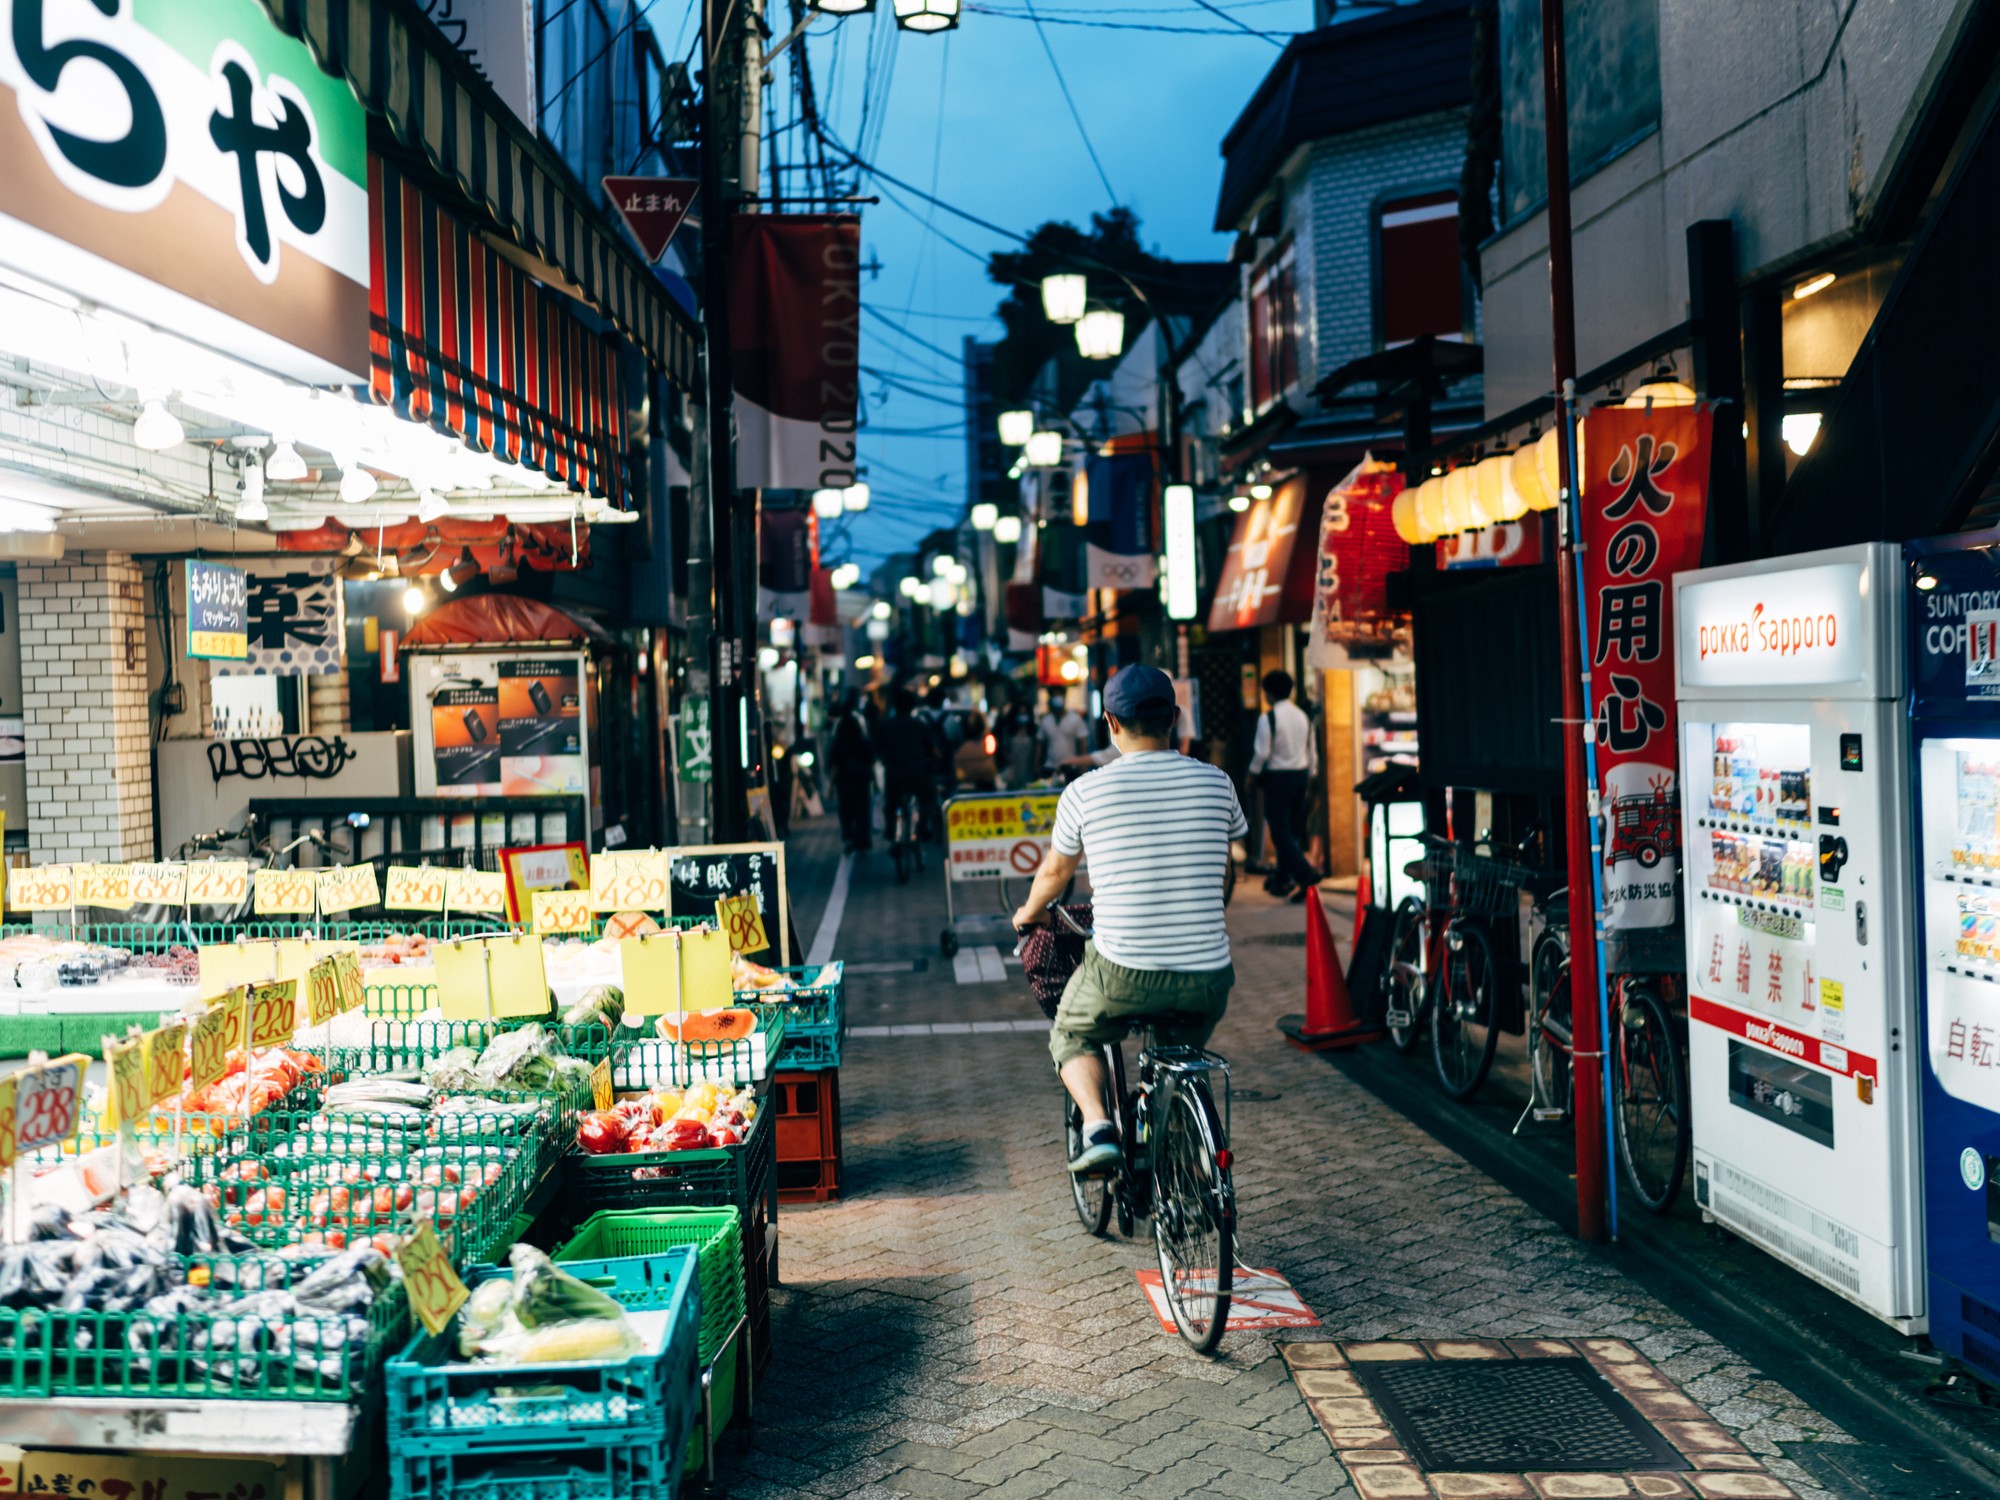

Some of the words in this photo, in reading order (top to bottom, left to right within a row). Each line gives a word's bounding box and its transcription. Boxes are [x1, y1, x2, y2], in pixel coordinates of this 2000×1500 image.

[623, 193, 683, 213] 止まれ
[819, 380, 859, 490] 2020
[1594, 433, 1679, 755] 火の用心
[1926, 589, 2000, 619] SUNTORY
[1758, 614, 1837, 657] sapporo
[680, 861, 732, 890] 快眠
[1610, 882, 1676, 902] 火防災協
[1708, 932, 1816, 1012] 駐輪禁止
[1948, 1017, 2000, 1070] 自転
[18, 1086, 74, 1143] 298
[28, 1474, 96, 1494] 山梨の
